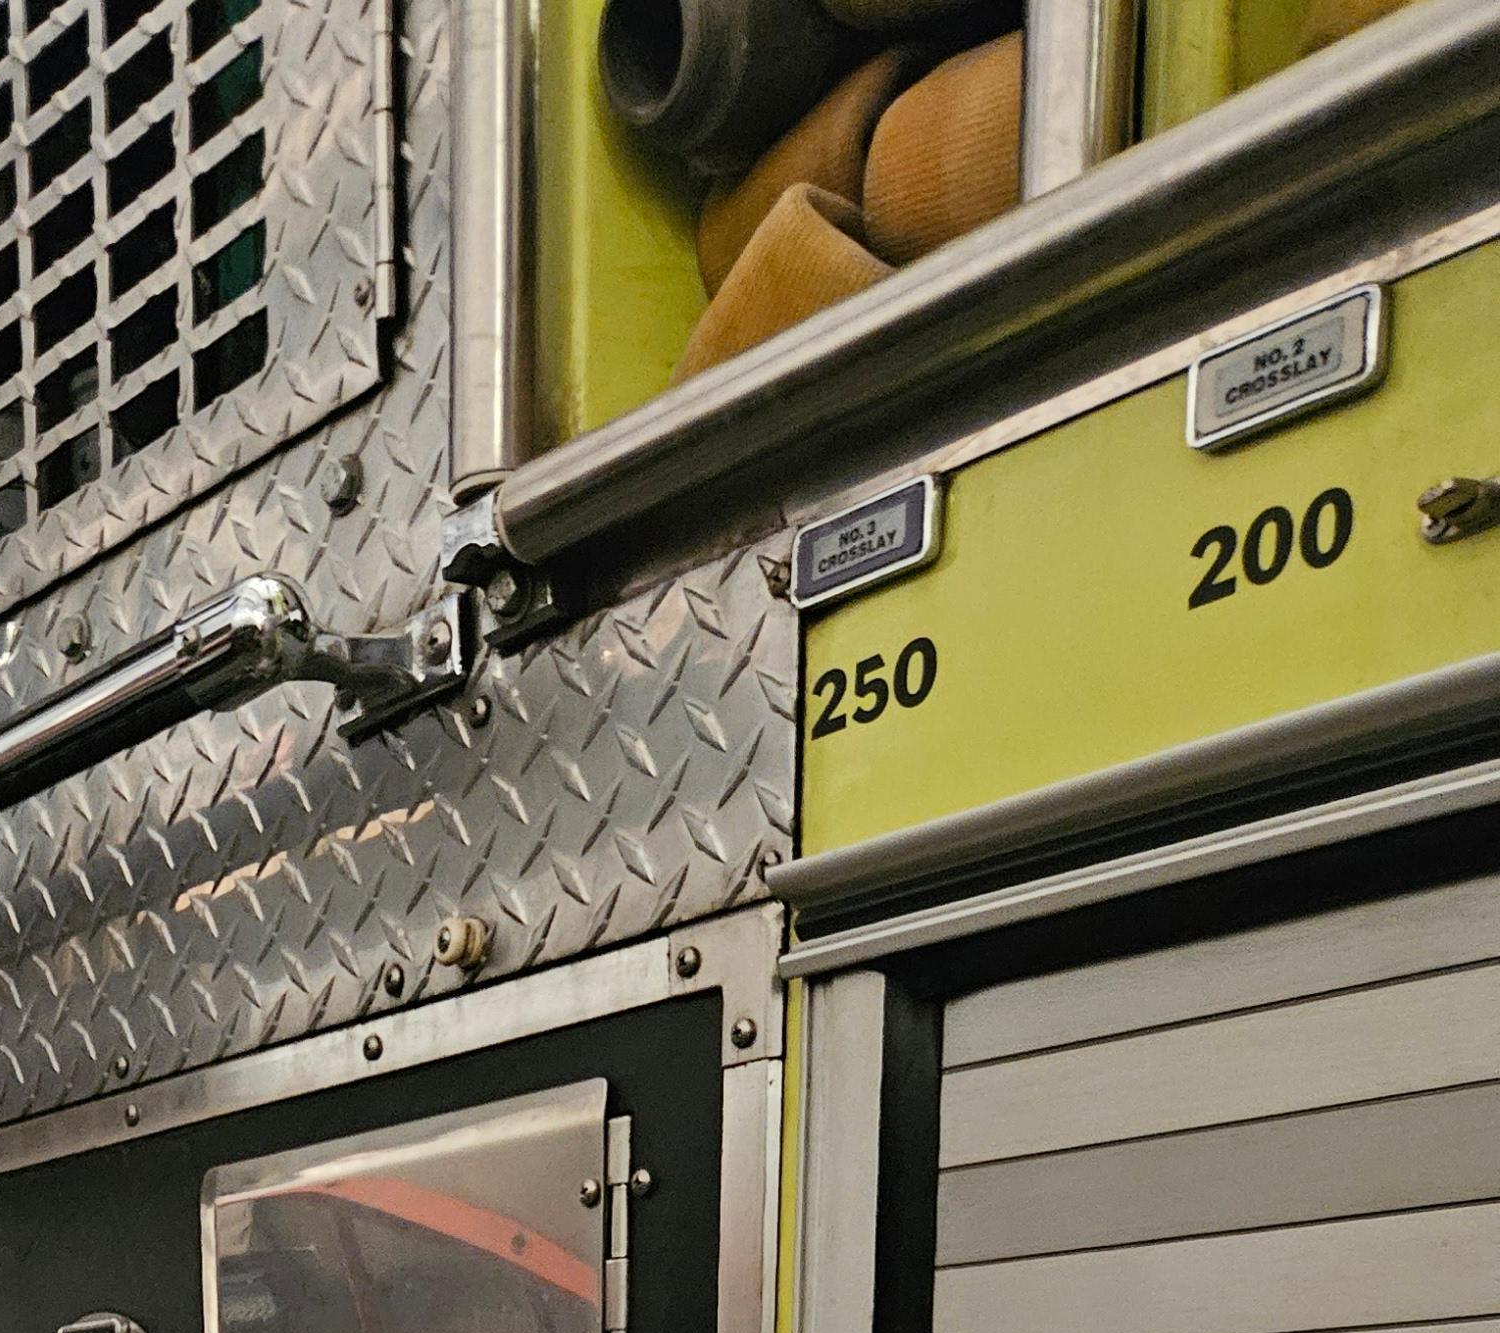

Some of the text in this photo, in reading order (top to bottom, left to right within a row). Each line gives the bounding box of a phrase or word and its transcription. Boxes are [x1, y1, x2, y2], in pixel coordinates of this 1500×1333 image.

[1224, 346, 1333, 405] CROSSLAY
[1253, 337, 1306, 372] NO. 2
[817, 529, 898, 574] CROSSLAY
[838, 520, 877, 548] NO. 3
[1187, 486, 1354, 612] 200
[810, 636, 938, 742] 250
